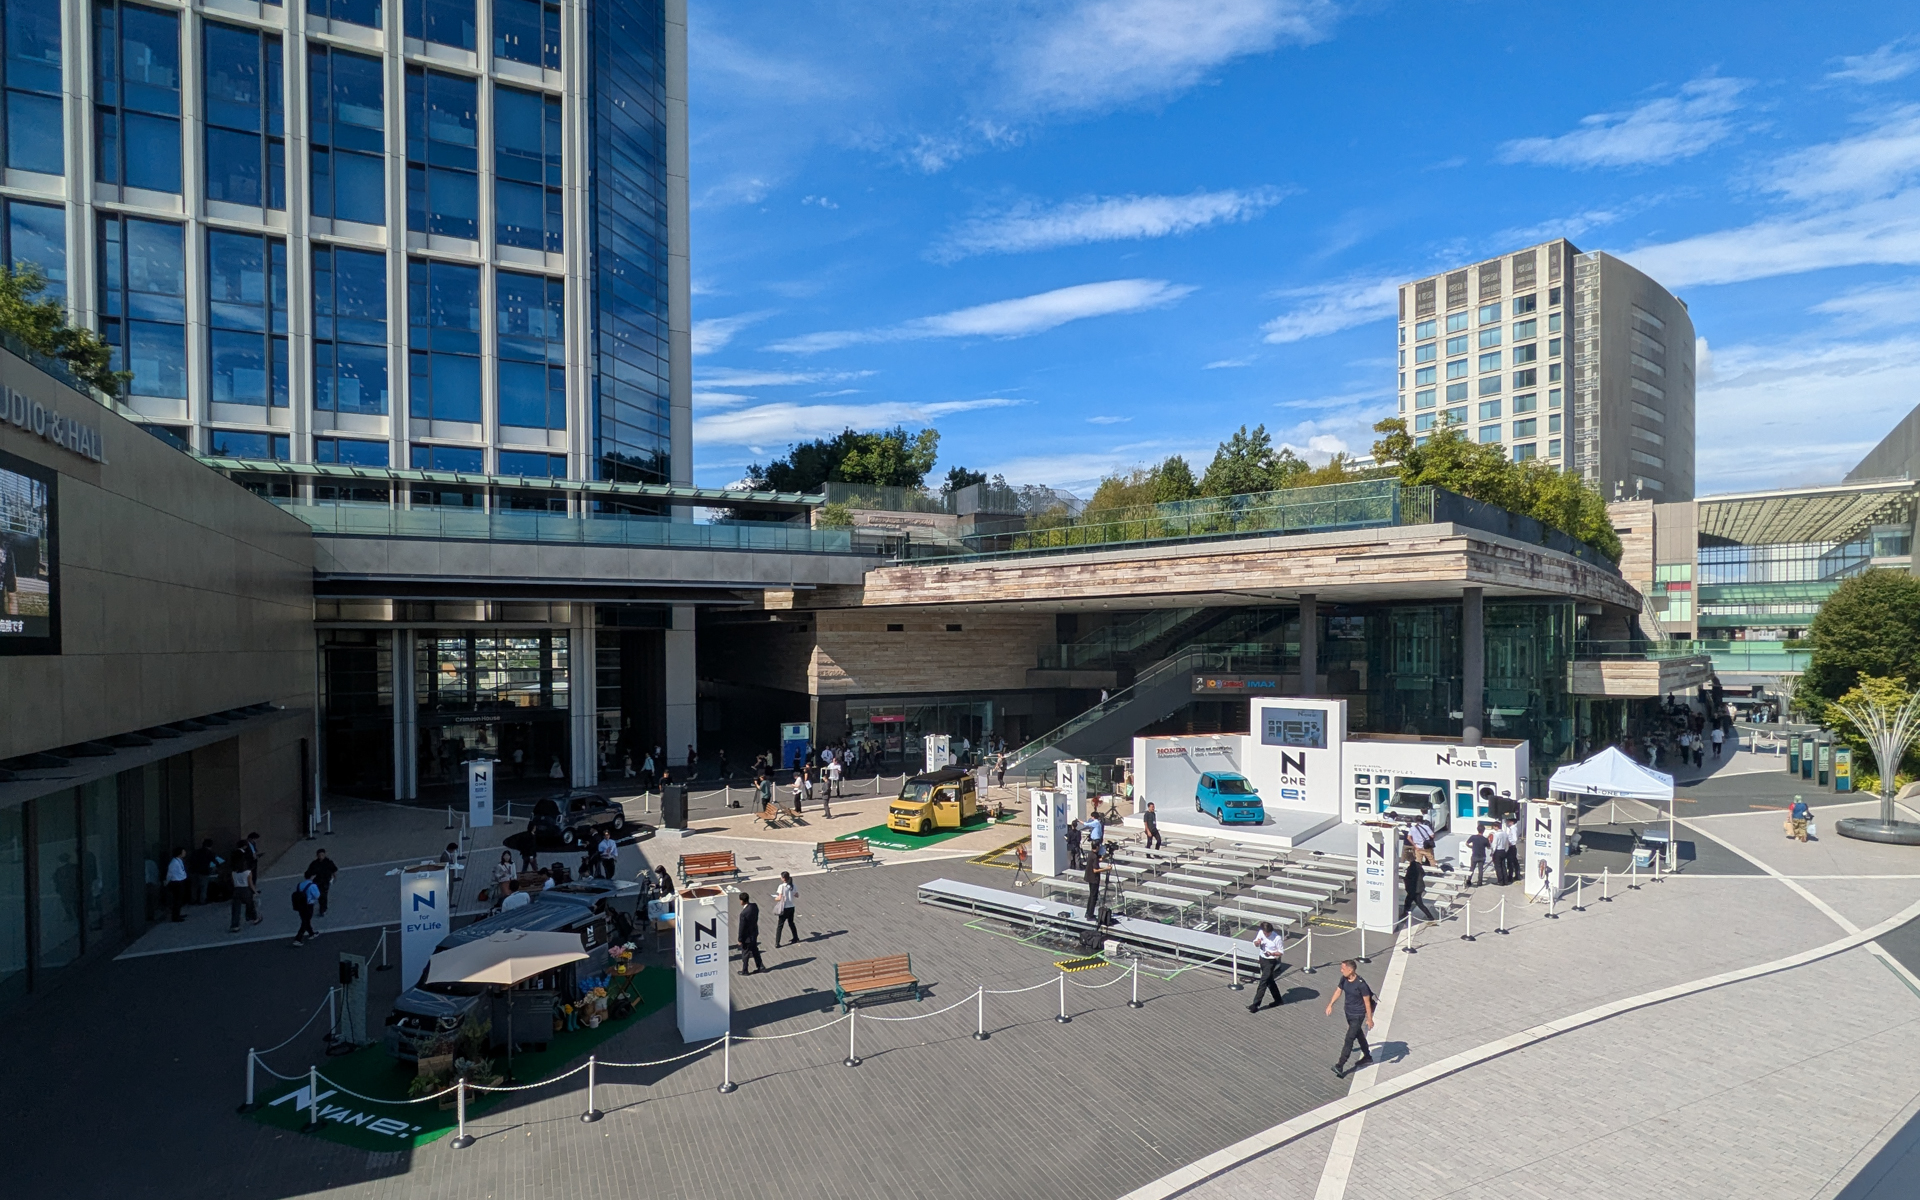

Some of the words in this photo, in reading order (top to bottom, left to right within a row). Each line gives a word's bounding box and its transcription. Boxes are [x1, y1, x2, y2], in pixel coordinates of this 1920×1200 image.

[52, 410, 64, 446] &
[69, 418, 110, 465] HALL
[937, 744, 946, 753] N
[1281, 751, 1306, 776] N
[475, 772, 486, 782] N
[1062, 774, 1072, 784] N
[1281, 776, 1306, 786] ONE
[1037, 804, 1048, 817] N
[1057, 803, 1064, 817] N
[1535, 818, 1551, 833] N
[1367, 842, 1384, 859] N
[413, 891, 435, 911] N
[407, 924, 421, 932] EV
[423, 922, 441, 931] Life
[587, 925, 594, 934] N
[695, 918, 717, 942] N
[694, 942, 717, 951] ONE
[695, 970, 718, 979] DEBUT!
